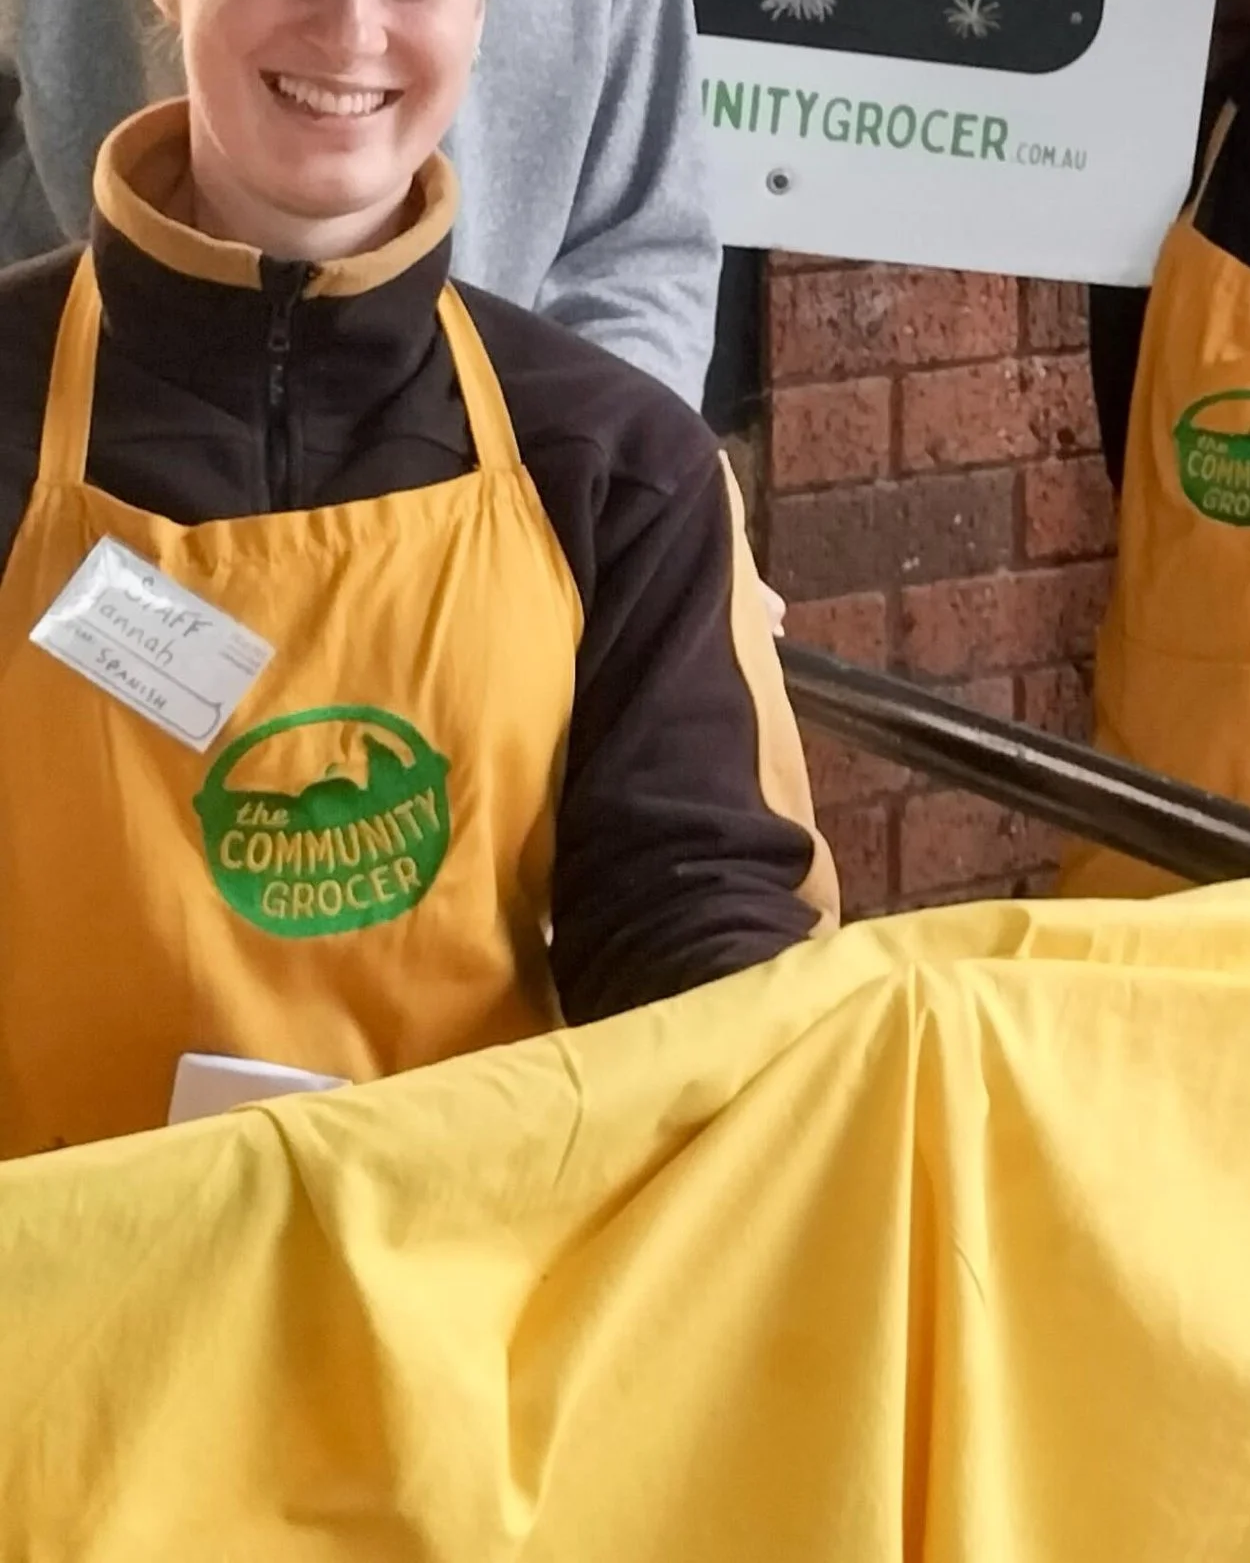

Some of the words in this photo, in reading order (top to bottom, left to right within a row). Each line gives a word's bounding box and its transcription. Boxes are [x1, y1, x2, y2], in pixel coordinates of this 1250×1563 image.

[124, 576, 213, 637] SAFF
[96, 647, 167, 710] SPANISH
[220, 788, 440, 876] COMMUNITY
[236, 802, 290, 826] the
[262, 857, 421, 919] GROCER
